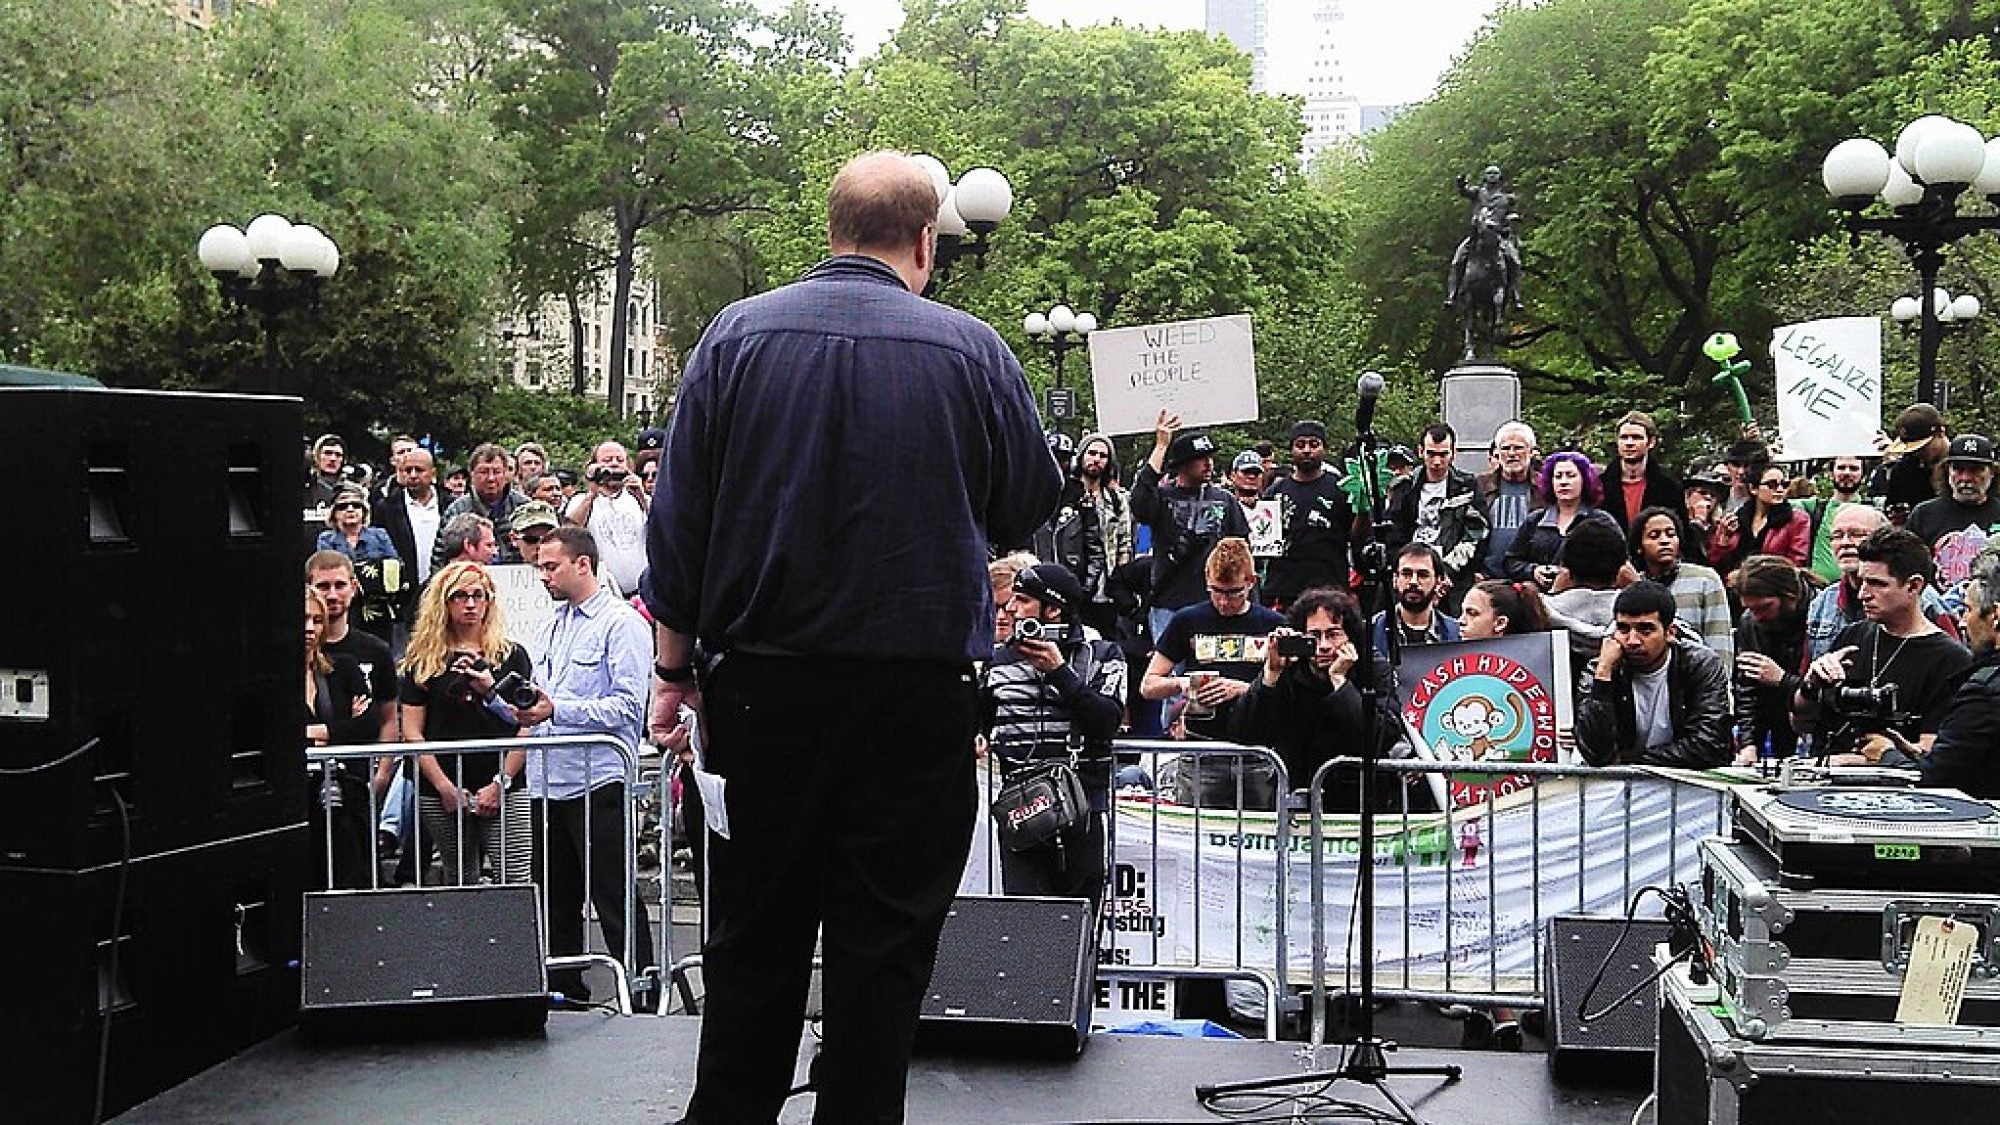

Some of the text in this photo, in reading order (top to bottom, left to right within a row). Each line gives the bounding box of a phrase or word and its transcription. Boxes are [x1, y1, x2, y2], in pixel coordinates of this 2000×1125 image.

[1144, 323, 1216, 348] WEED
[1139, 350, 1179, 367] THE
[1780, 328, 1879, 401] LEGALIZE
[1130, 362, 1203, 388] PEOPLE
[1786, 377, 1847, 420] ME
[1412, 654, 1546, 708] CASH HYDE
[1117, 981, 1167, 1011] THE
